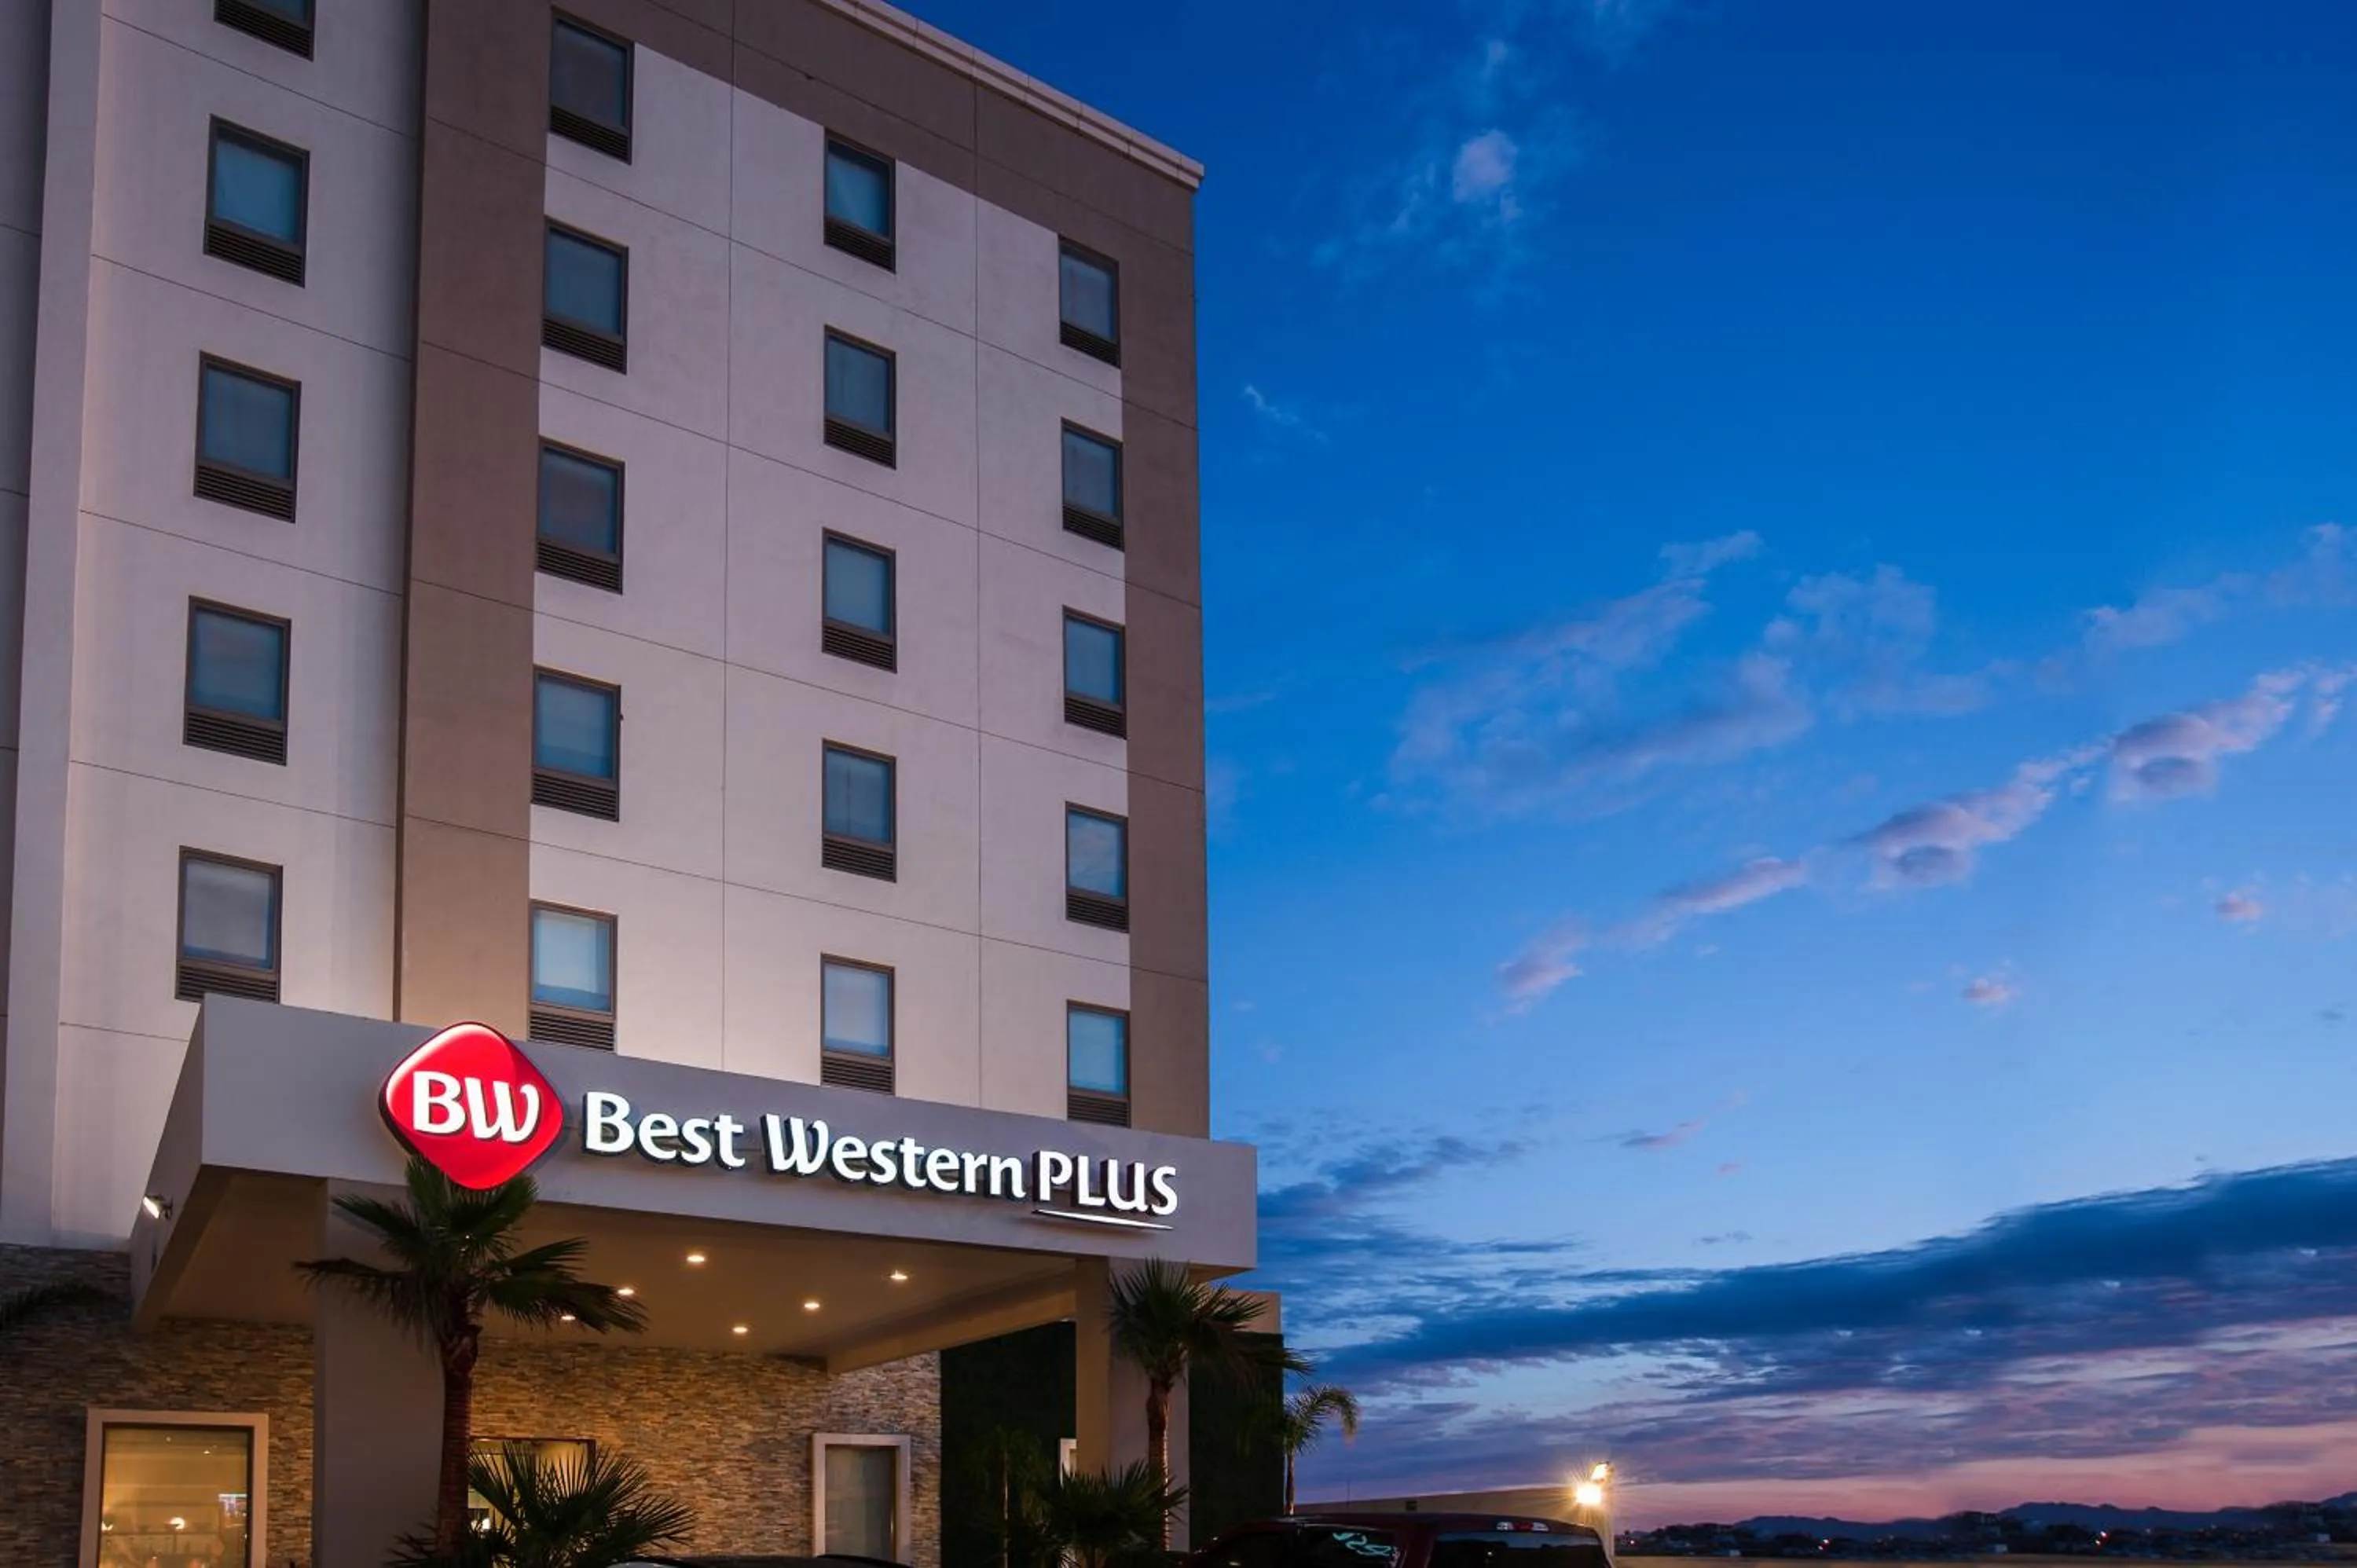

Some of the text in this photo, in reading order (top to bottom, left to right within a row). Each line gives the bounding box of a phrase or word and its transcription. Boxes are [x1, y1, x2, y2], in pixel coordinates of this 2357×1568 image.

[412, 1071, 540, 1142] BW
[585, 1091, 1178, 1215] Best Western PLUS
